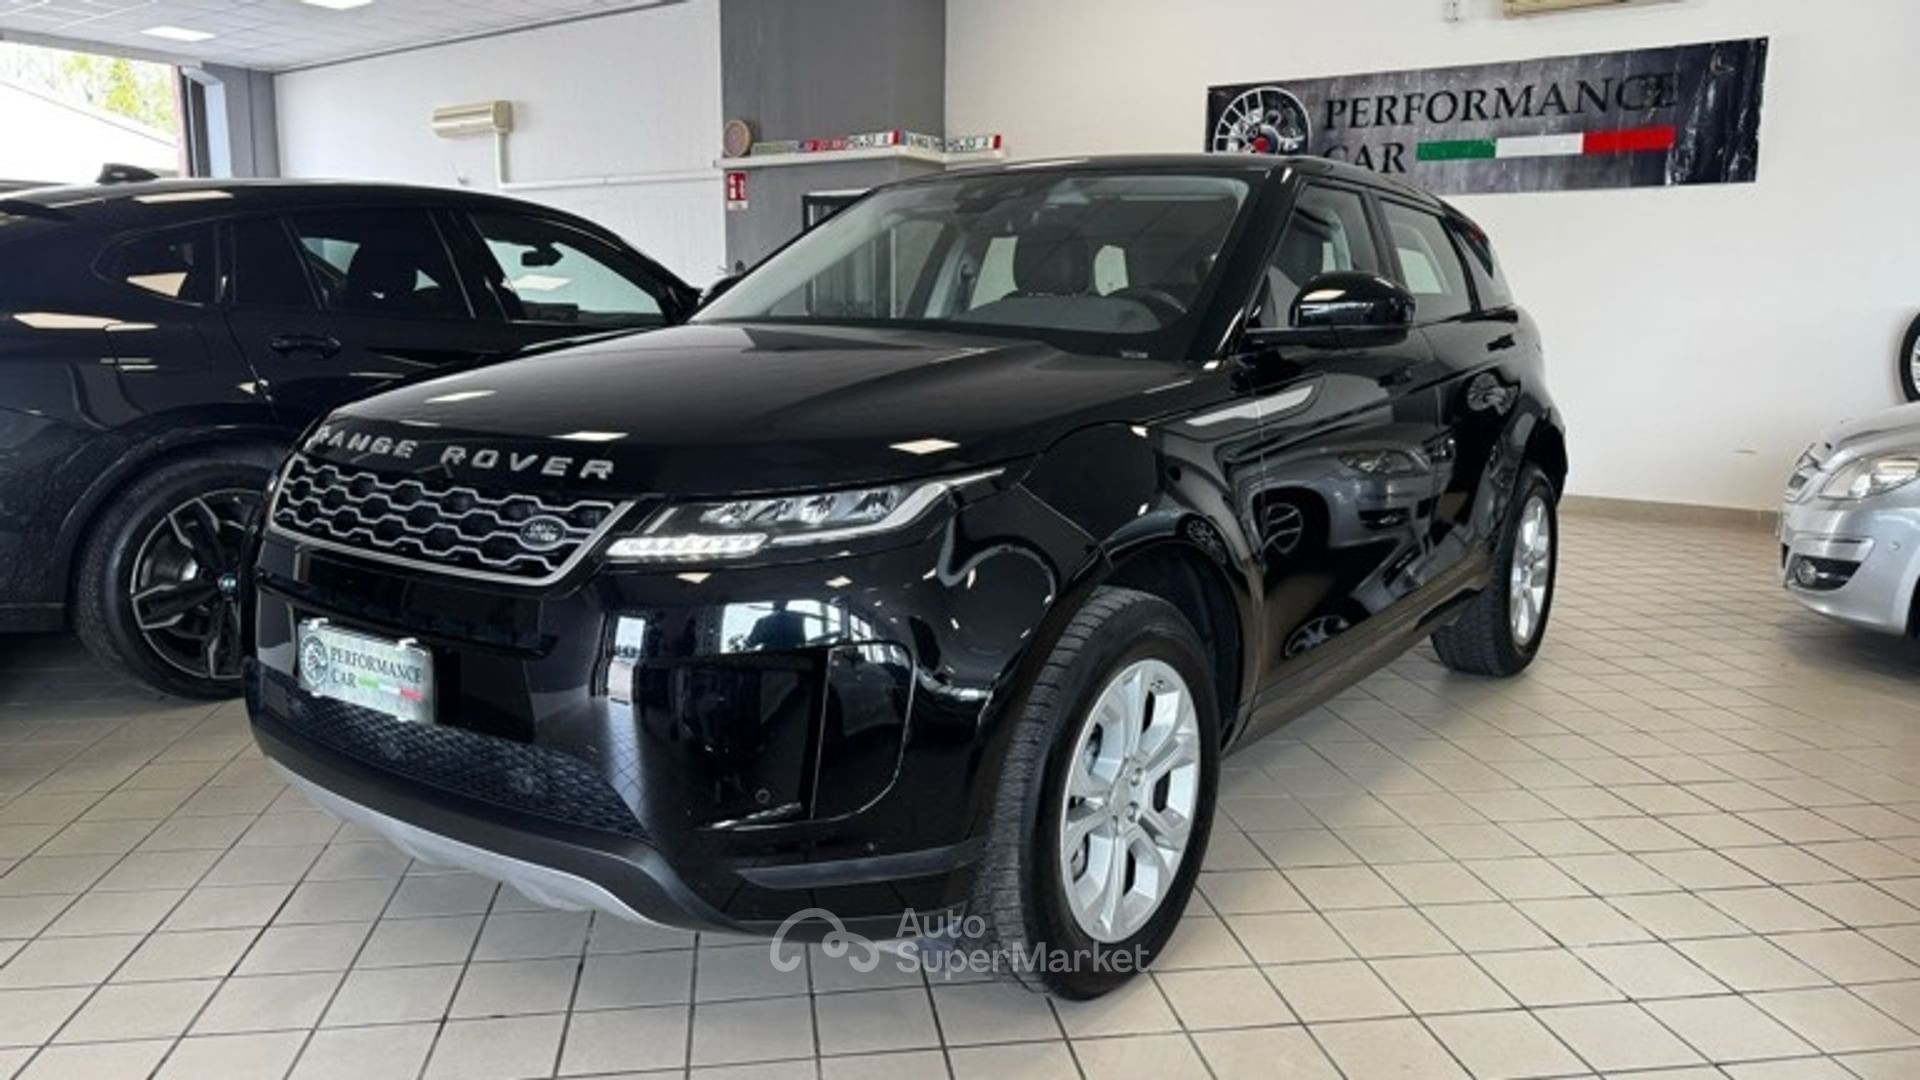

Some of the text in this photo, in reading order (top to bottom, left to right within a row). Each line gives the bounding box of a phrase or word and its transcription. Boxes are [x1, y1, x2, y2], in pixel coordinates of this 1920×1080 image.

[1323, 72, 1676, 130] PERFORMANCE
[312, 425, 615, 480] RANGE ROVER
[330, 646, 422, 684] PERFORMANCE
[330, 667, 357, 689] CAR
